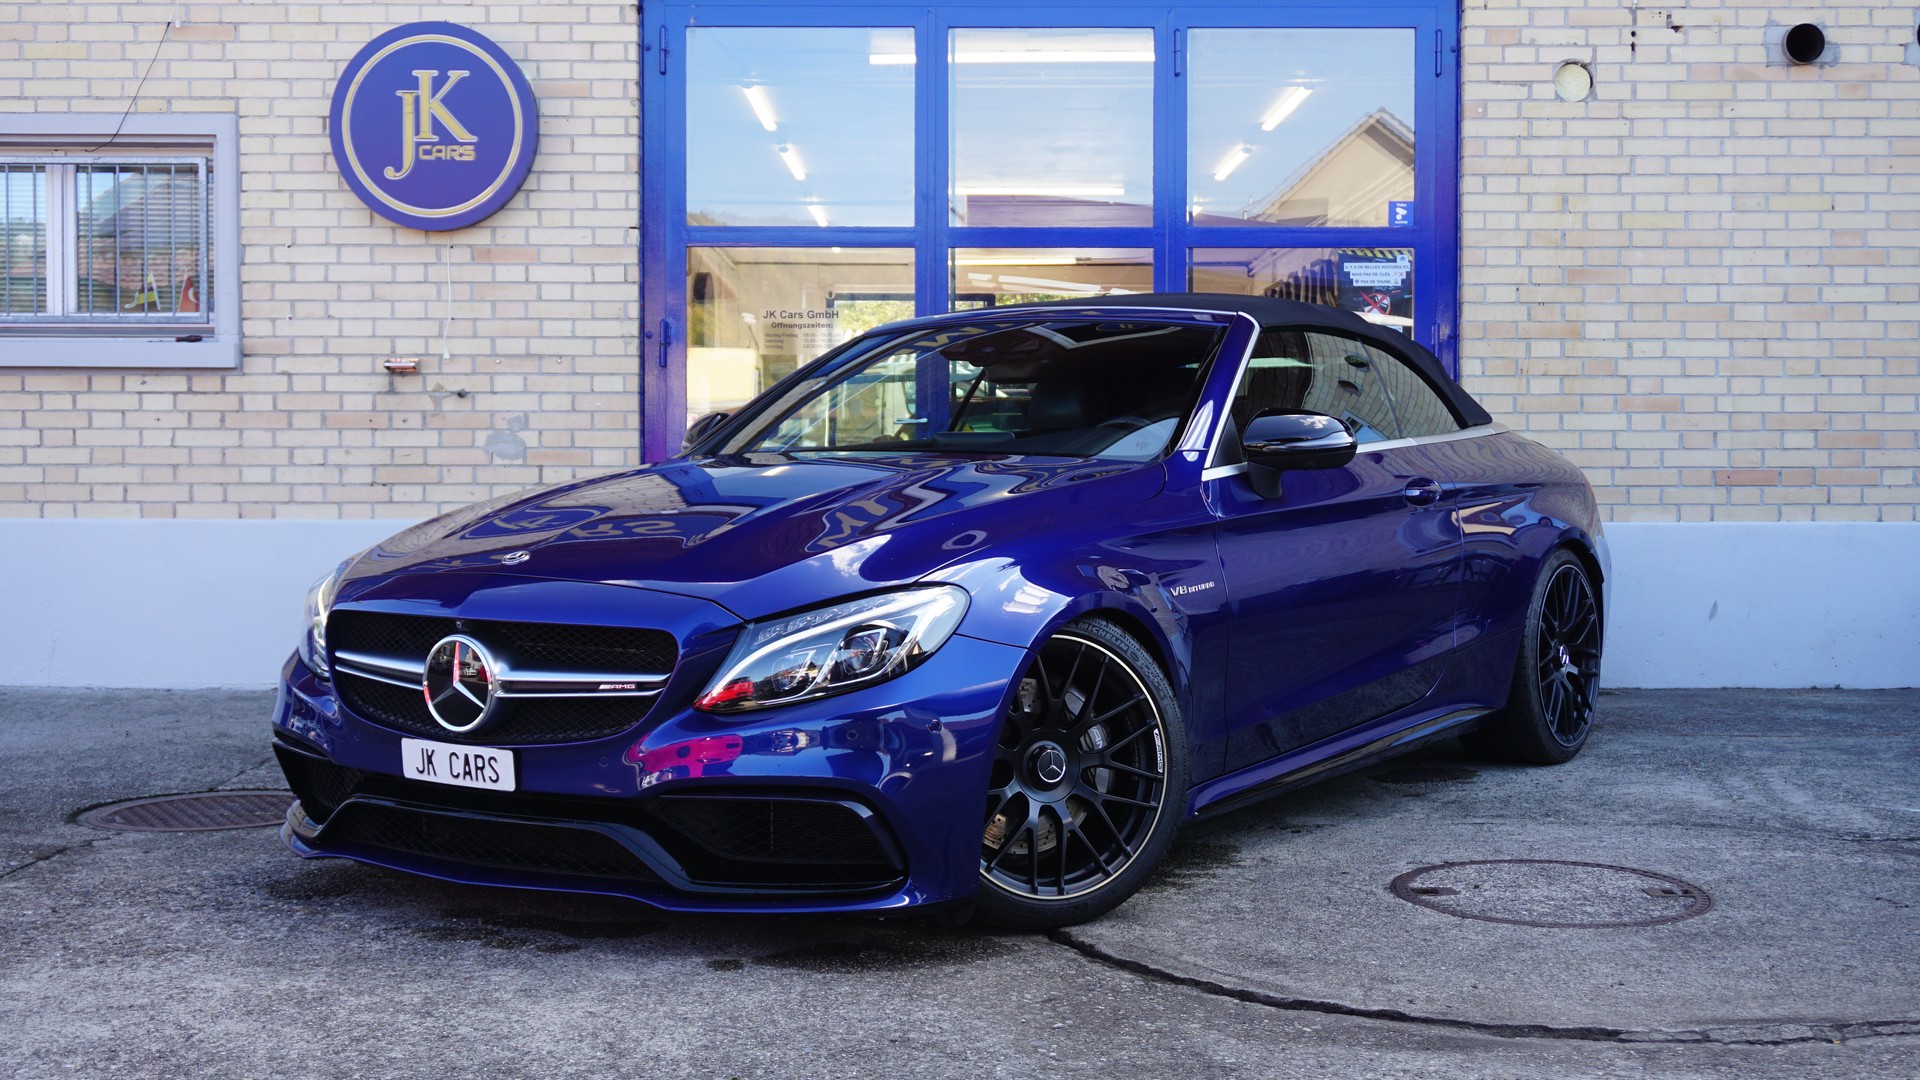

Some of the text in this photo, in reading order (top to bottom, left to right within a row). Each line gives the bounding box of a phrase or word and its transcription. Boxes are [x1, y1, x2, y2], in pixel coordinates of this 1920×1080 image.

[384, 70, 478, 179] JK
[418, 145, 476, 160] CARS
[763, 310, 839, 319] JK Cars GmbH
[771, 321, 833, 329] Öffnungszeiten:
[1170, 581, 1215, 596] V8 BITURBO
[1078, 621, 1129, 651] MICHELIN
[416, 747, 500, 784] JK CARS
